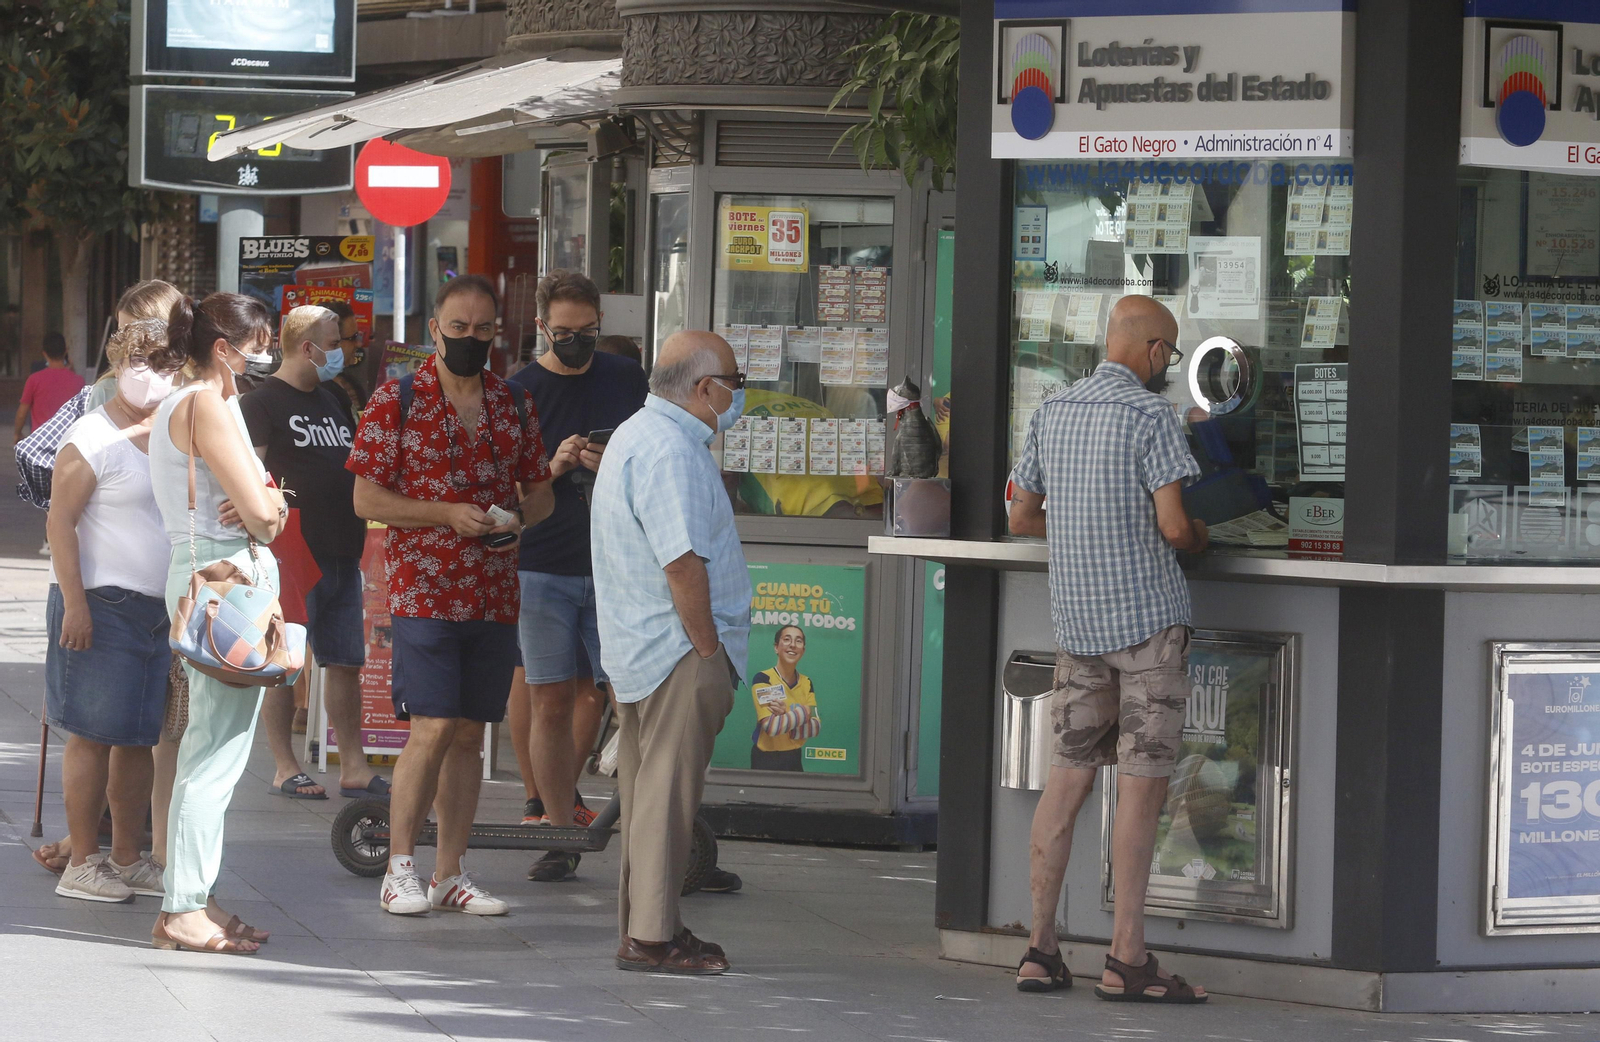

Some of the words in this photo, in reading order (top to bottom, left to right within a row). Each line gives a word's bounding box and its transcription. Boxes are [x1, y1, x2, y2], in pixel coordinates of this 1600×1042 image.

[231, 58, 269, 67] JCDecaux
[1077, 39, 1179, 68] Loterías
[1182, 45, 1201, 73] y
[1077, 77, 1193, 110] Apuestas
[1197, 73, 1237, 102] del
[1241, 73, 1332, 102] Estado
[1079, 136, 1090, 153] El
[1094, 136, 1128, 153] Gato
[1132, 136, 1177, 157] Negro
[1195, 133, 1302, 153] Administración
[1323, 134, 1333, 151] 4
[1568, 145, 1579, 163] El
[1026, 160, 1353, 187] www.la4decordoba.com
[1551, 187, 1596, 199] 15.246
[728, 212, 757, 222] BOTE
[728, 222, 765, 232] viernes
[771, 218, 801, 244] 35
[733, 236, 755, 246] EURO
[1551, 238, 1596, 250] 10.528
[242, 238, 310, 259] BLUES
[726, 245, 763, 255] JACKPOT
[769, 250, 802, 258] MILLONES
[1218, 261, 1245, 269] 13954
[310, 289, 347, 299] ANIMALES
[1314, 367, 1337, 379] BOTES
[1551, 402, 1573, 414] DEL
[289, 415, 353, 448] Smile
[1306, 505, 1335, 518] EBER
[1300, 541, 1313, 549] 902
[1314, 541, 1322, 549] 15
[756, 582, 824, 598] CUANDO
[809, 598, 831, 613] TÚ
[802, 612, 856, 631] TODOS
[1194, 664, 1205, 684] SI
[1208, 665, 1230, 686] CAE
[364, 713, 371, 724] 2
[817, 749, 844, 759] ONCE
[1521, 744, 1535, 757] 4
[1538, 744, 1566, 757] DE
[1521, 761, 1560, 774] BOTE
[1519, 829, 1600, 844] MILLONE
